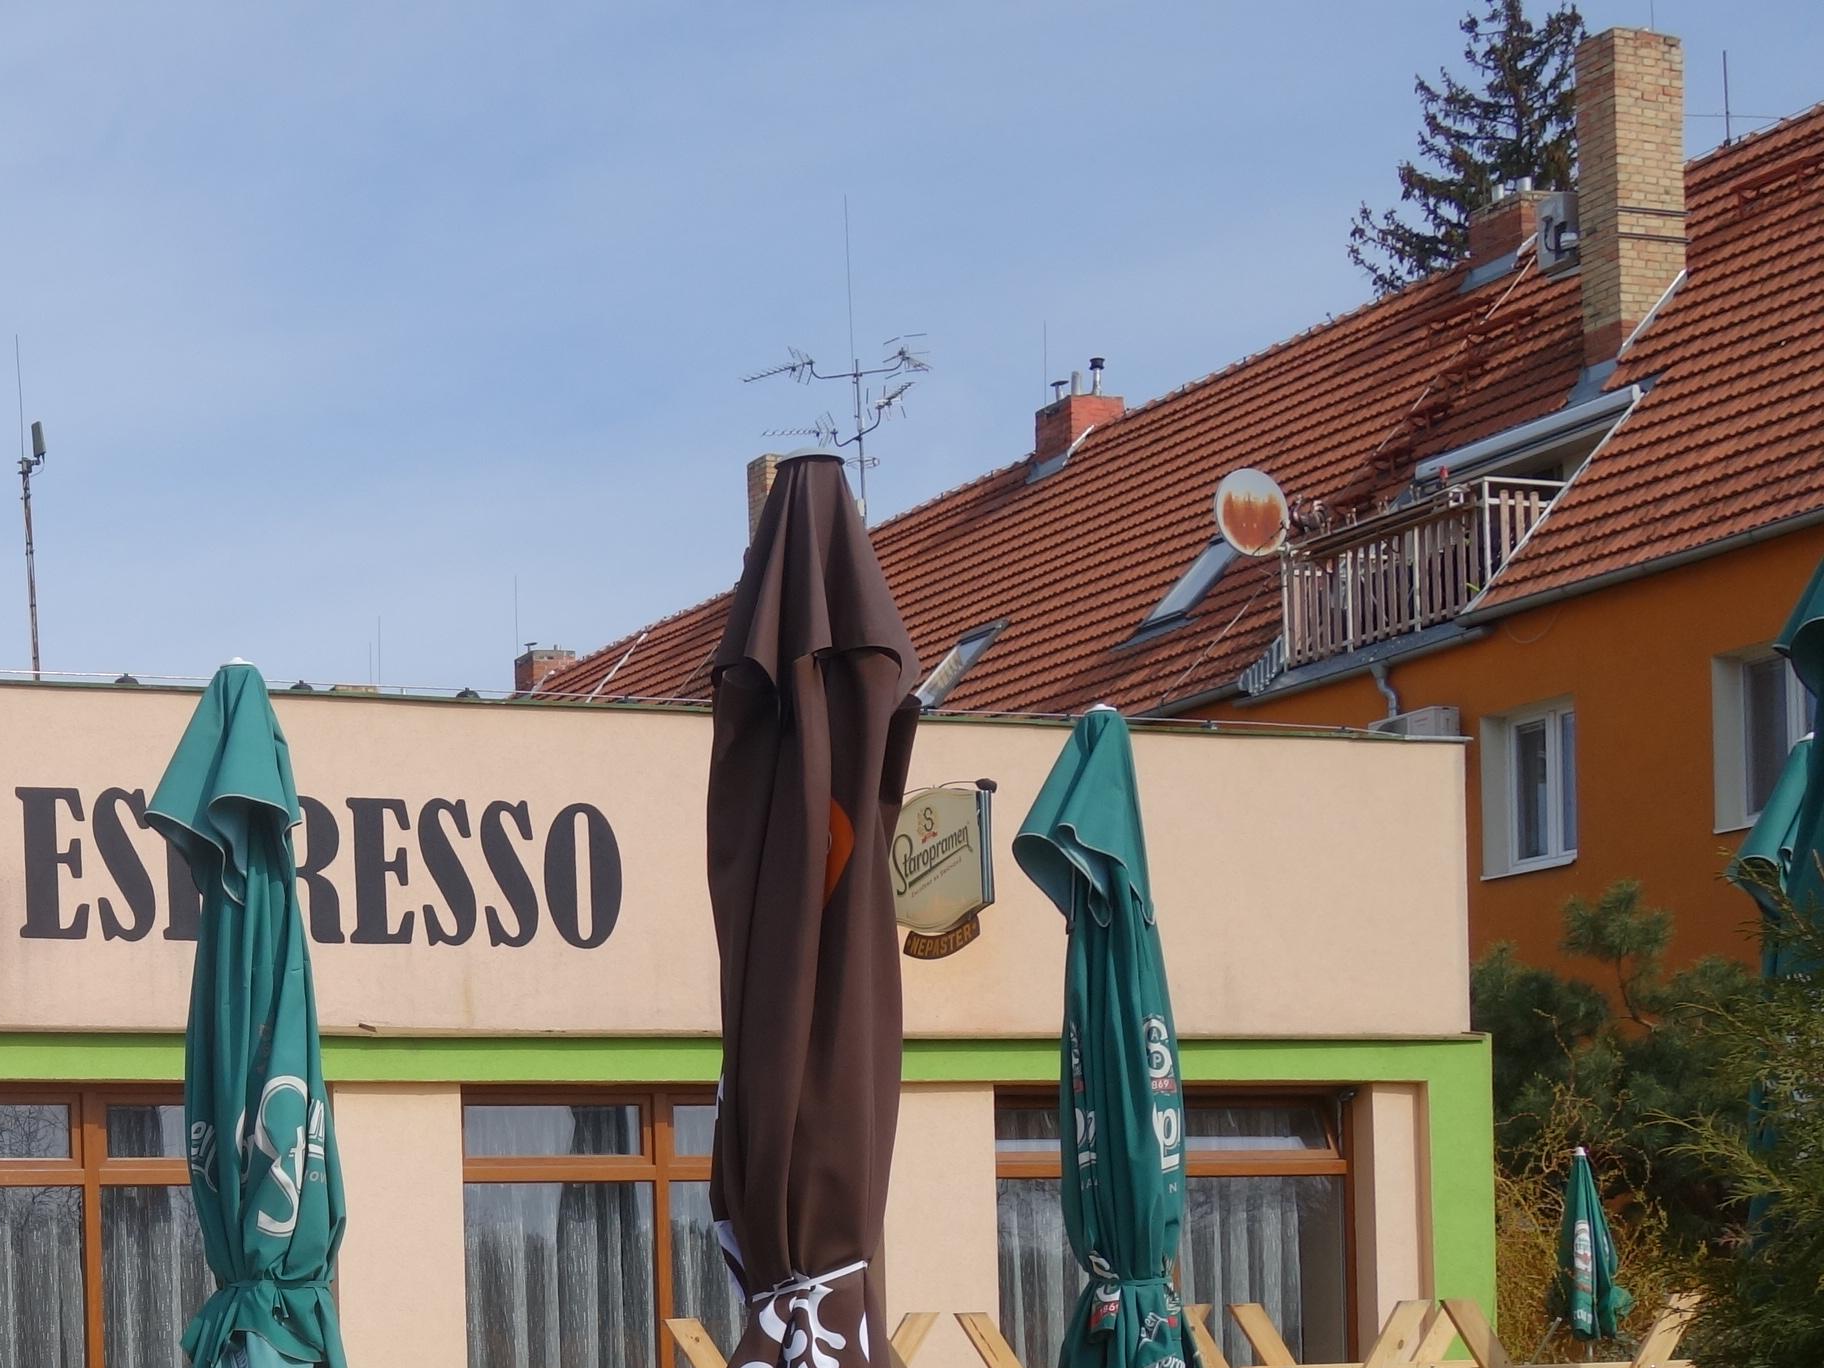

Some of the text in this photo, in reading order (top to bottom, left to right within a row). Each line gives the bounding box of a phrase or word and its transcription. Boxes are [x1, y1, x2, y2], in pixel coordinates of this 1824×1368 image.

[15, 785, 623, 950] ESRESSO
[892, 825, 973, 896] Staropramen
[910, 922, 972, 957] NEPASTER
